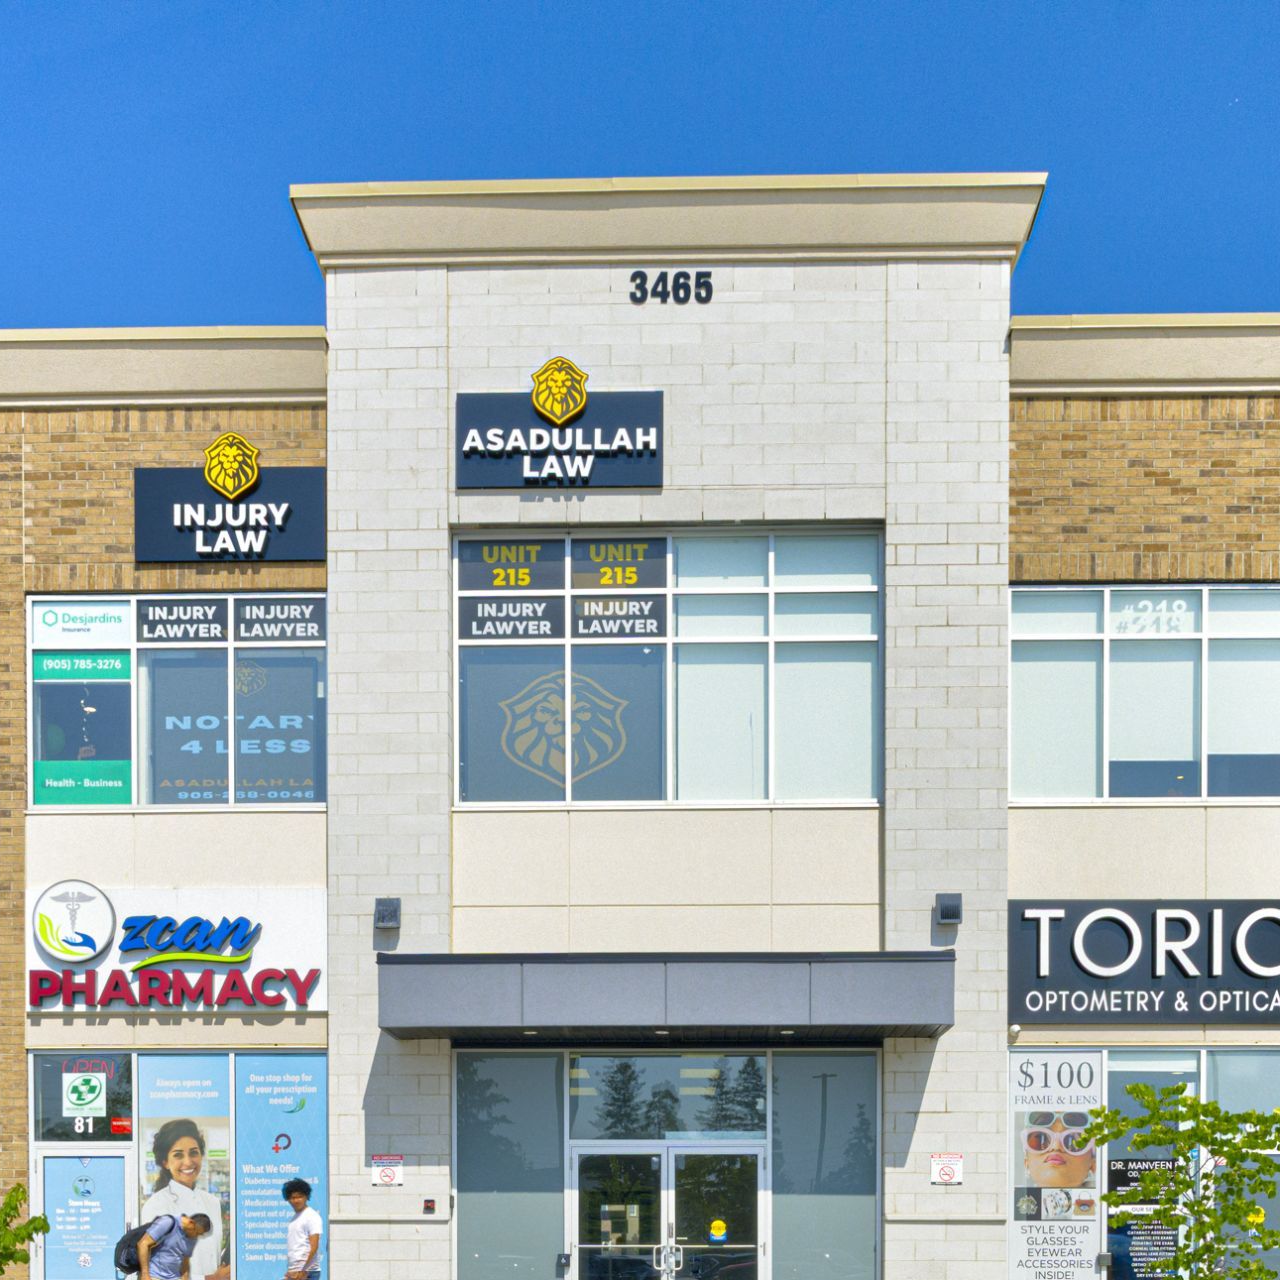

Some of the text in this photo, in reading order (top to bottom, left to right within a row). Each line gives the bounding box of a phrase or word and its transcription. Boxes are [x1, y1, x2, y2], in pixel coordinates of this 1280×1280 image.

[629, 271, 714, 304] 3465
[463, 427, 658, 451] ASADULLAH
[523, 455, 595, 477] LAW
[173, 502, 289, 527] INJURY
[195, 530, 267, 553] LAW
[482, 545, 541, 563] UNIT
[589, 544, 648, 562] UNIT
[492, 568, 531, 586] 215
[600, 566, 638, 585] 215
[148, 606, 217, 621] INJURY
[244, 604, 314, 620] INJURY
[477, 603, 547, 617] INJURY
[583, 601, 654, 616] INJURY
[62, 611, 122, 626] Desjardins
[143, 624, 222, 639] LAWYER
[239, 622, 319, 638] LAWYER
[472, 621, 552, 635] LAWYER
[578, 619, 658, 634] LAWYER
[42, 658, 122, 671] (905) 785-3276
[165, 714, 314, 730] NOAR
[180, 739, 312, 754] 4 LESS
[45, 778, 123, 788] Health Business
[29, 968, 322, 1007] PHARMACY
[1026, 990, 1165, 1012] OPTOMETRY
[1174, 990, 1189, 1012] &
[249, 1073, 313, 1083] One stop shop for
[1017, 1058, 1095, 1091] $100
[245, 1085, 317, 1095] all your prescription
[269, 1097, 294, 1105] needs!
[1014, 1095, 1098, 1105] FRAME & LENS
[74, 1116, 94, 1134] 81
[242, 1164, 300, 1174] What We Offer
[1111, 1161, 1126, 1170] DR.
[1127, 1161, 1173, 1170] MANVEEN
[1021, 1225, 1090, 1234] STYLE YOUR
[1026, 1236, 1077, 1246] GLASSES
[1027, 1248, 1082, 1257] EYEWEAR
[1017, 1260, 1093, 1269] ACCESSORIES
[1035, 1271, 1075, 1280] INSIDE!
